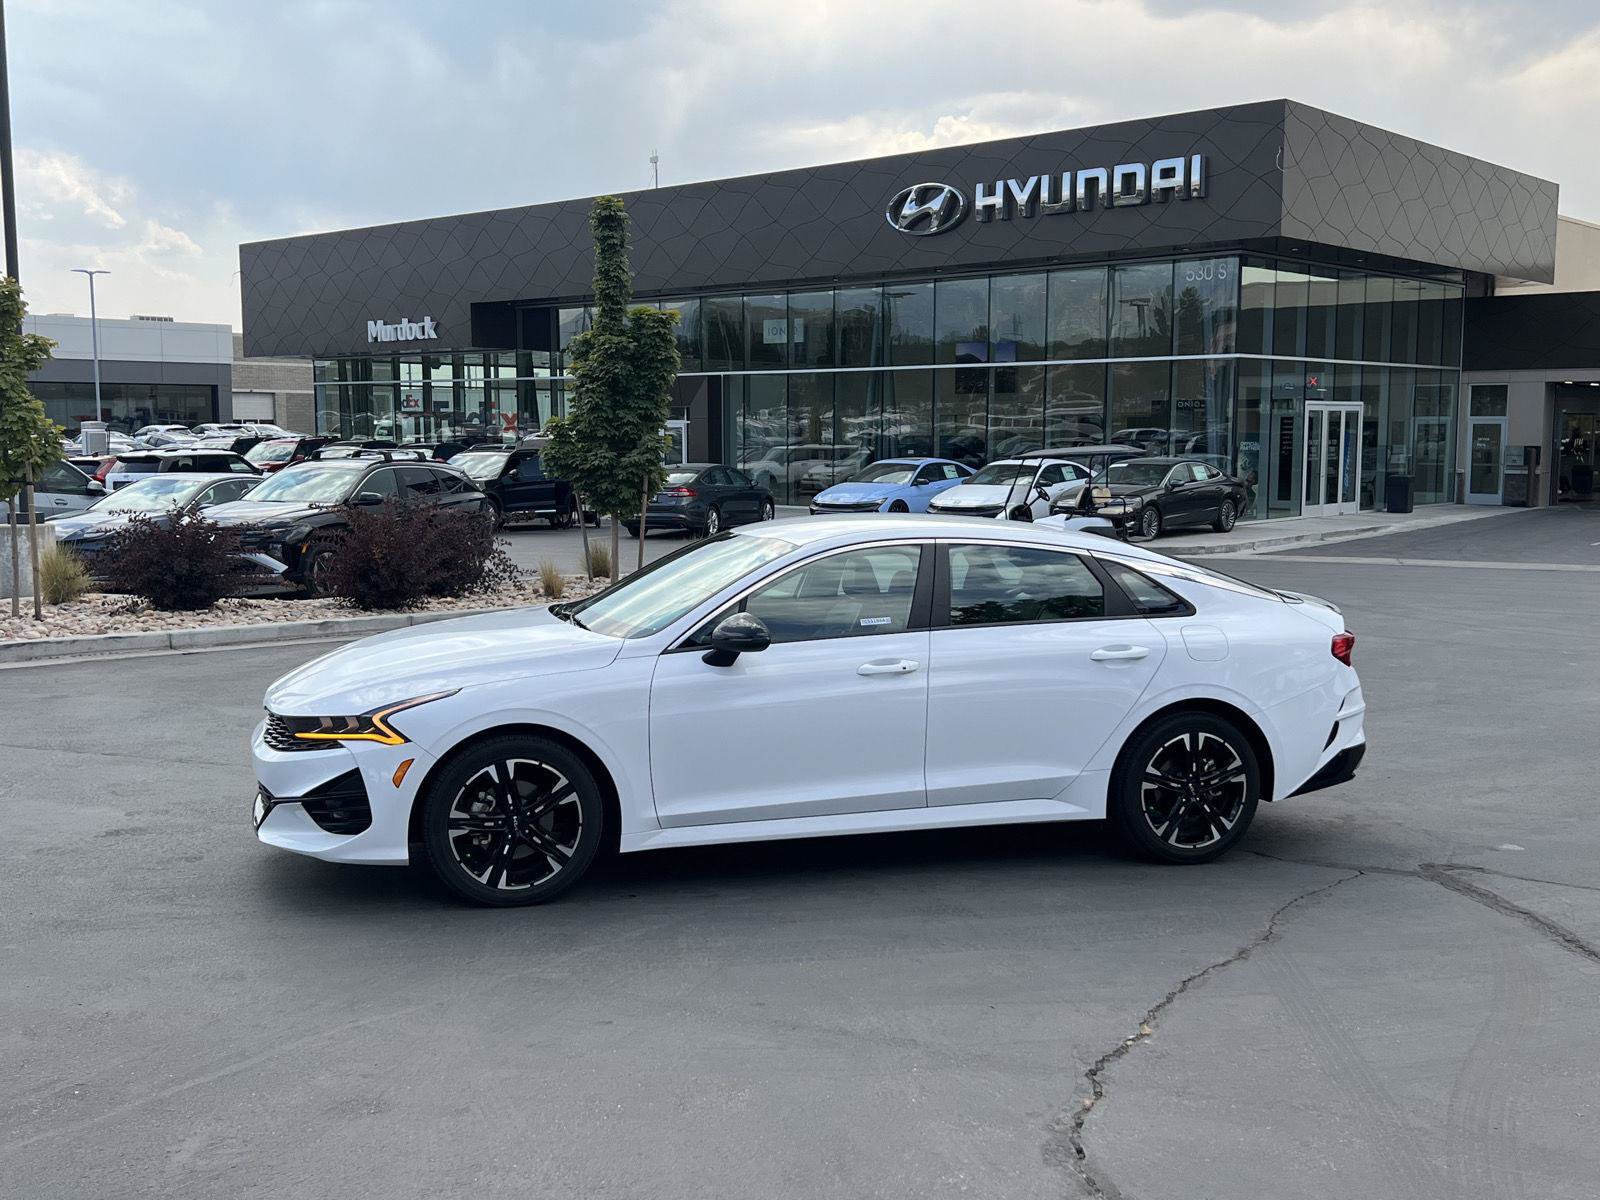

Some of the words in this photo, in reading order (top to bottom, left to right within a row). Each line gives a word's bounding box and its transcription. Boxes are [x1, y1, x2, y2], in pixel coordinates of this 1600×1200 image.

[974, 154, 1206, 223] HYUNDAI
[1186, 264, 1213, 282] 530
[367, 315, 438, 343] Murdock
